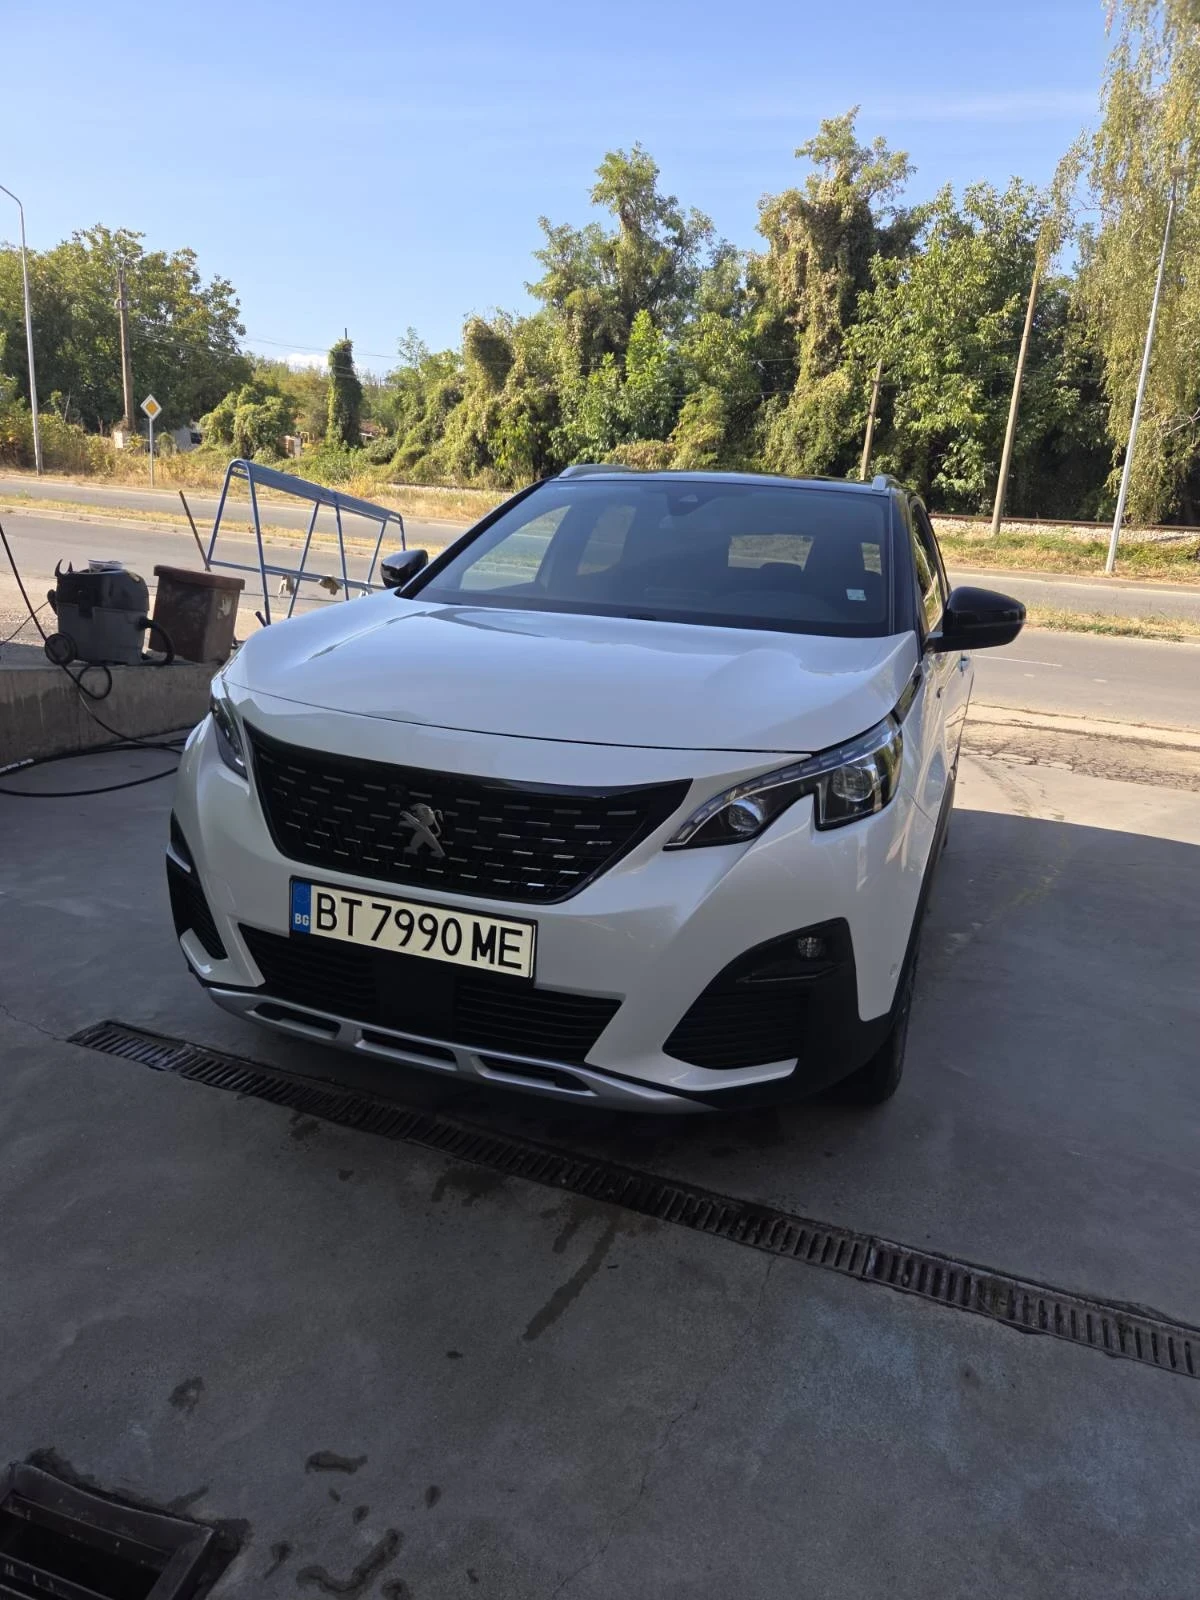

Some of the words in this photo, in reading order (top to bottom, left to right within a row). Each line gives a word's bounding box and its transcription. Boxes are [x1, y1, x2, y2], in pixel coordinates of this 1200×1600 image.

[294, 912, 310, 927] BG
[316, 892, 362, 936] BT
[371, 903, 462, 956] 7990
[471, 921, 523, 970] ME
